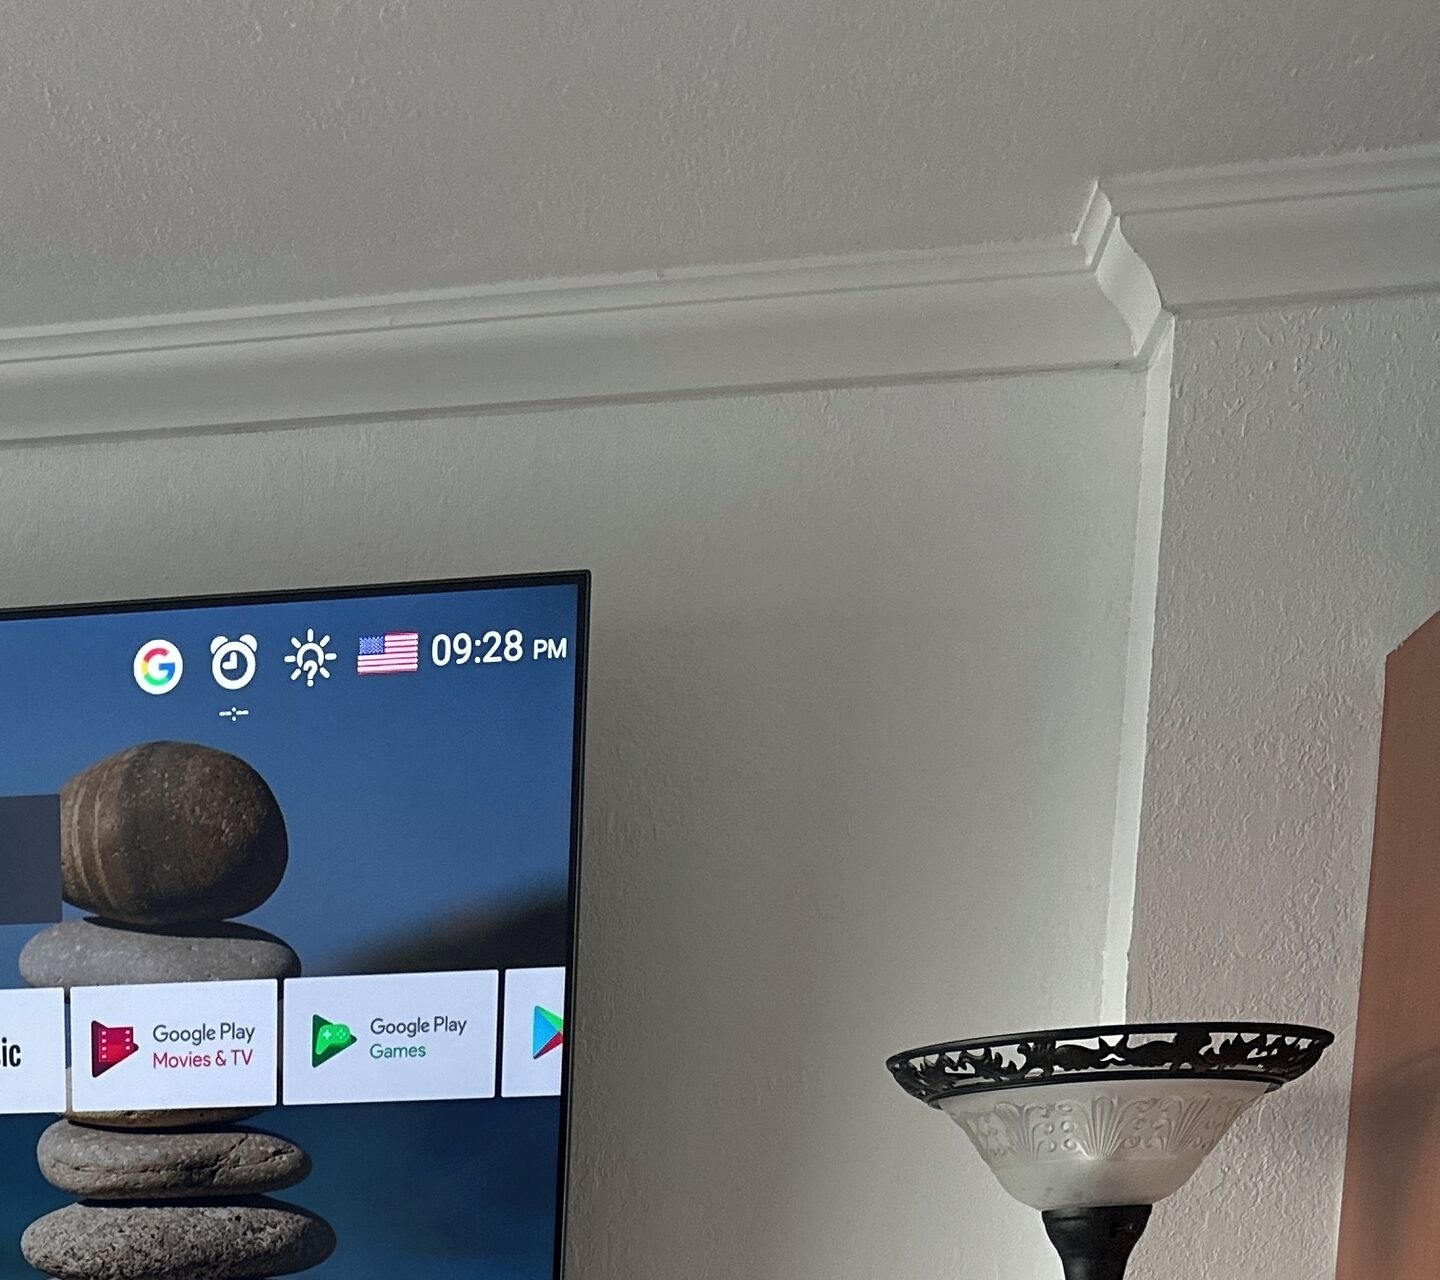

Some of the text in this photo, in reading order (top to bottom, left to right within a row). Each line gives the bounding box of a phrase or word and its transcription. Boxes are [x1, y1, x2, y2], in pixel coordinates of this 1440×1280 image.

[431, 629, 568, 667] 09:28 PM
[152, 1022, 256, 1046] Google Play
[370, 1015, 468, 1038] Google Play
[153, 1048, 254, 1069] Movies & TV
[369, 1043, 427, 1060] Games
